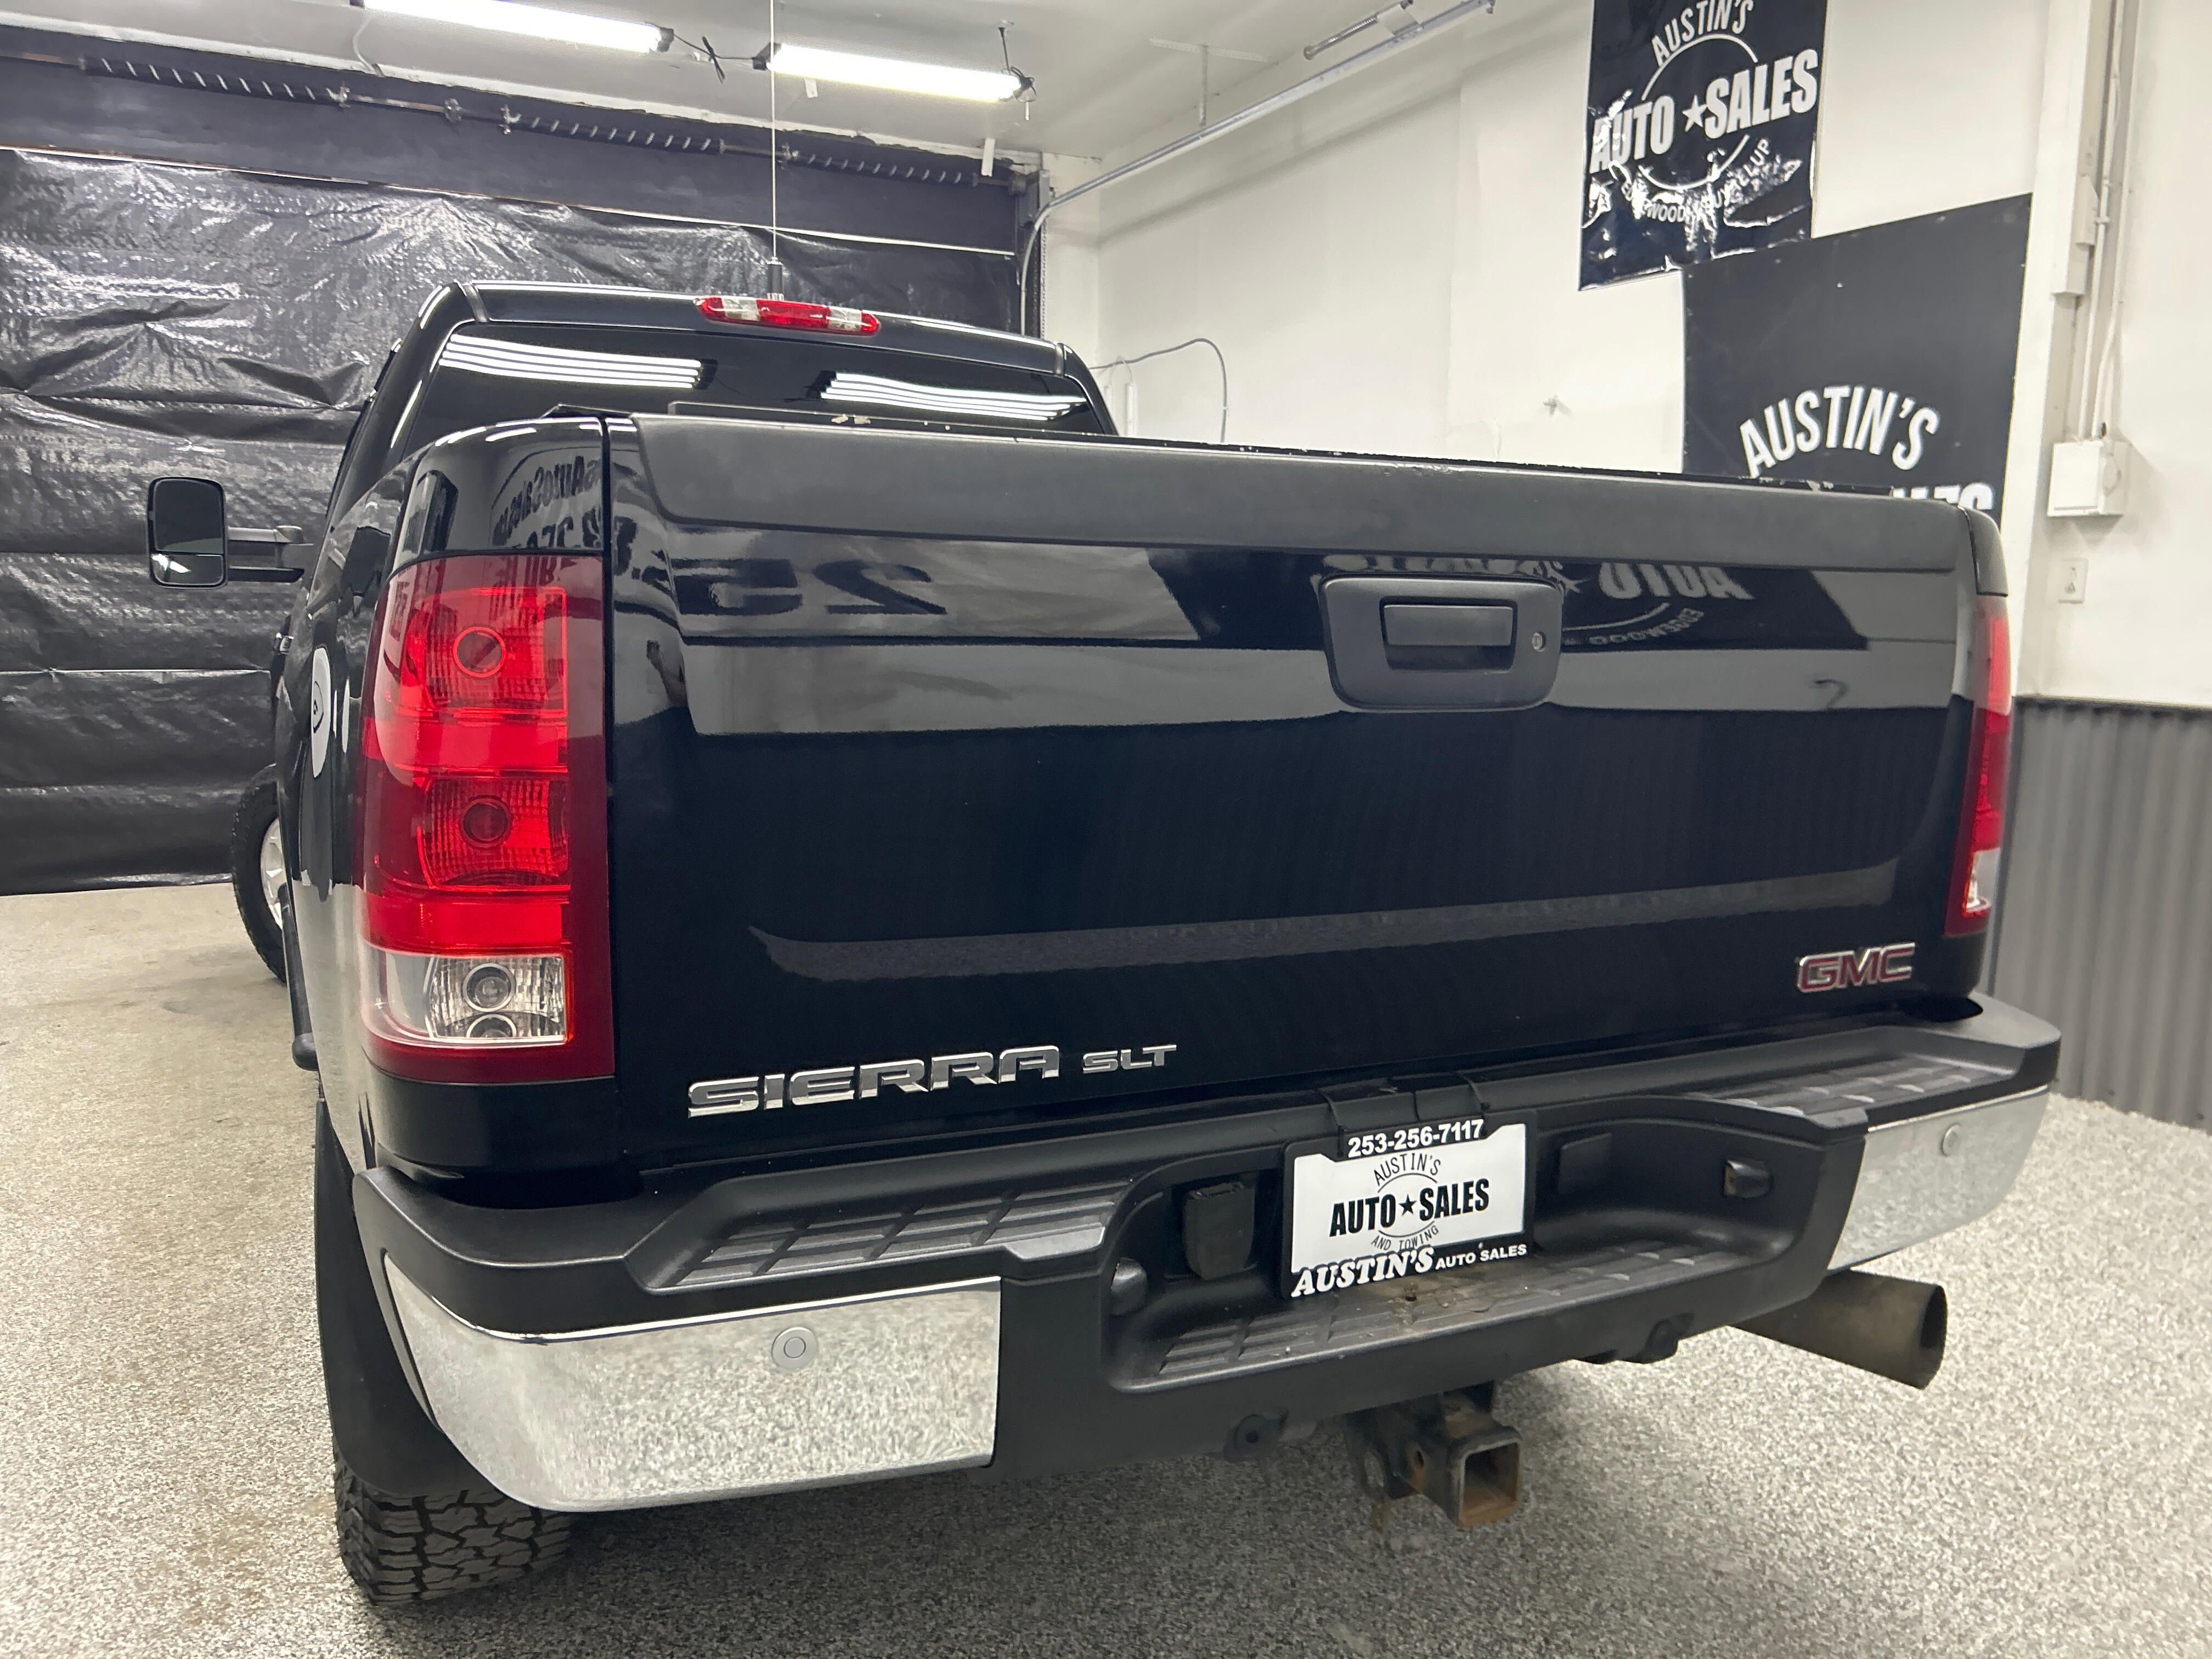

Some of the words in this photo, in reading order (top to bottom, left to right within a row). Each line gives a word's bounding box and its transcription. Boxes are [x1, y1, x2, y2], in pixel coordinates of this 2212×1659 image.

[1651, 0, 1754, 66] AUSTIN'S
[1589, 95, 1675, 173] AUTO
[1704, 48, 1818, 139] SALES
[1740, 385, 1940, 478] AUSTIN'S
[1797, 942, 1915, 992] GMC
[688, 1045, 1060, 1118] SIERRA
[1082, 1044, 1177, 1074] SLT
[1348, 1119, 1484, 1158] 253-256-7117
[1374, 1153, 1441, 1186] AUSTIN'S
[1329, 1194, 1396, 1237] AUTO
[1419, 1178, 1489, 1222] SALES
[1371, 1235, 1391, 1250] AND
[1399, 1225, 1439, 1250] TOWING
[1291, 1246, 1435, 1297] AUSTIN'S
[1436, 1252, 1476, 1270] AUTO
[1480, 1244, 1527, 1261] SALES
